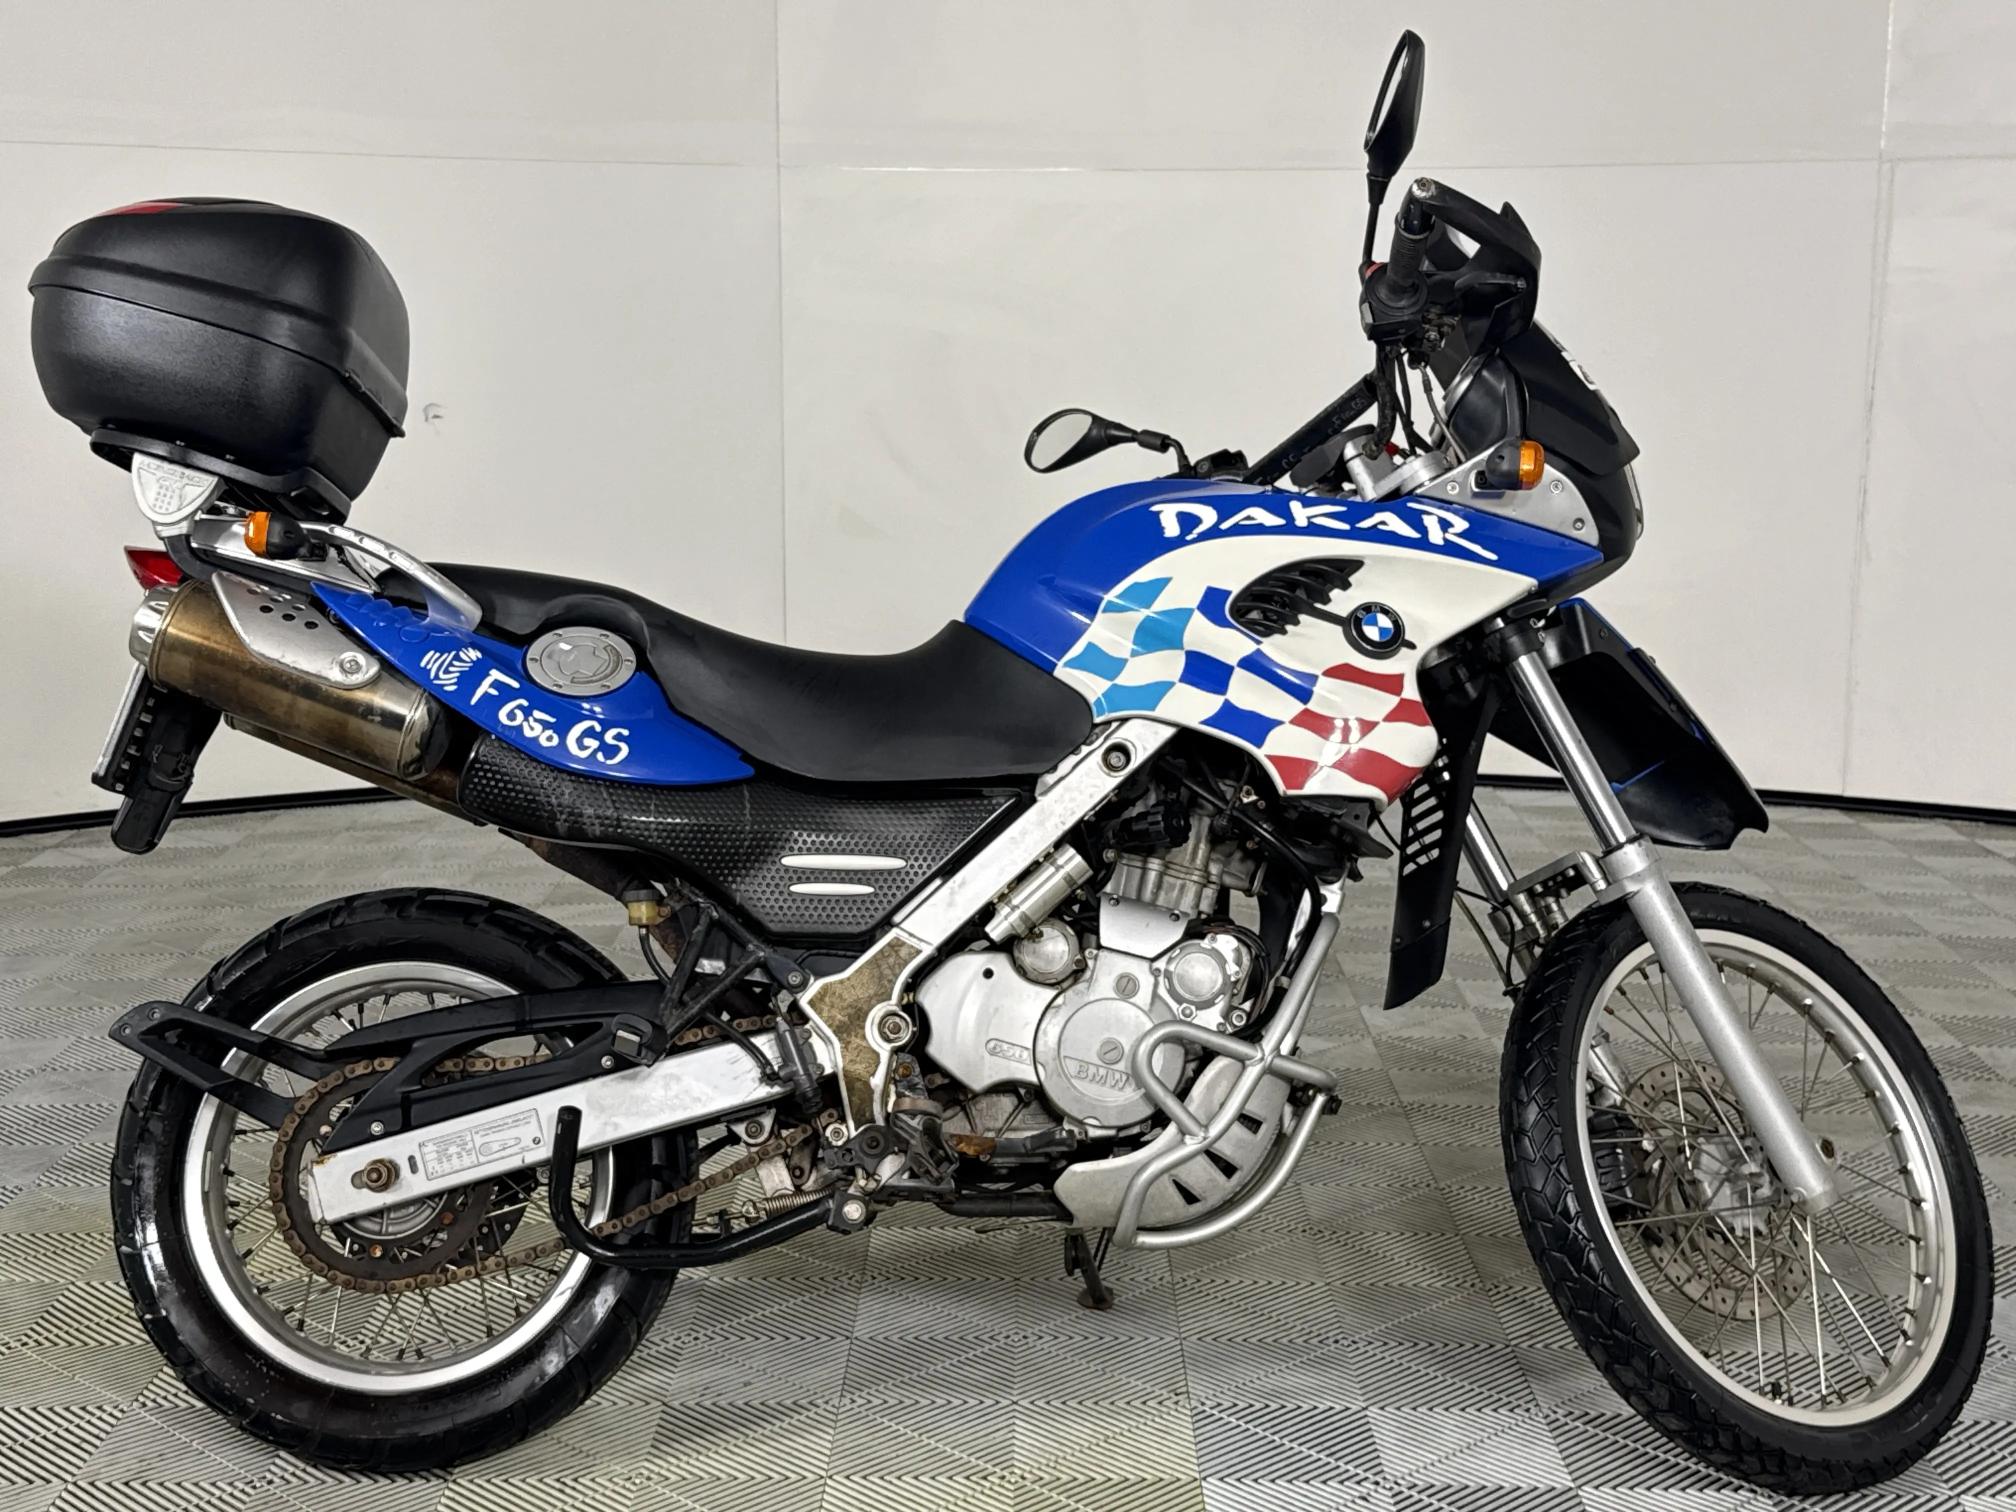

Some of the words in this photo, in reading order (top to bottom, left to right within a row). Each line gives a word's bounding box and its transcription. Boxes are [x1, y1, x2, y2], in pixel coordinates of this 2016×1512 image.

[1149, 500, 1499, 561] DAKAR
[469, 668, 521, 706] F
[498, 698, 560, 748] 650
[565, 719, 631, 766] GS
[1075, 1062, 1131, 1092] BMW
